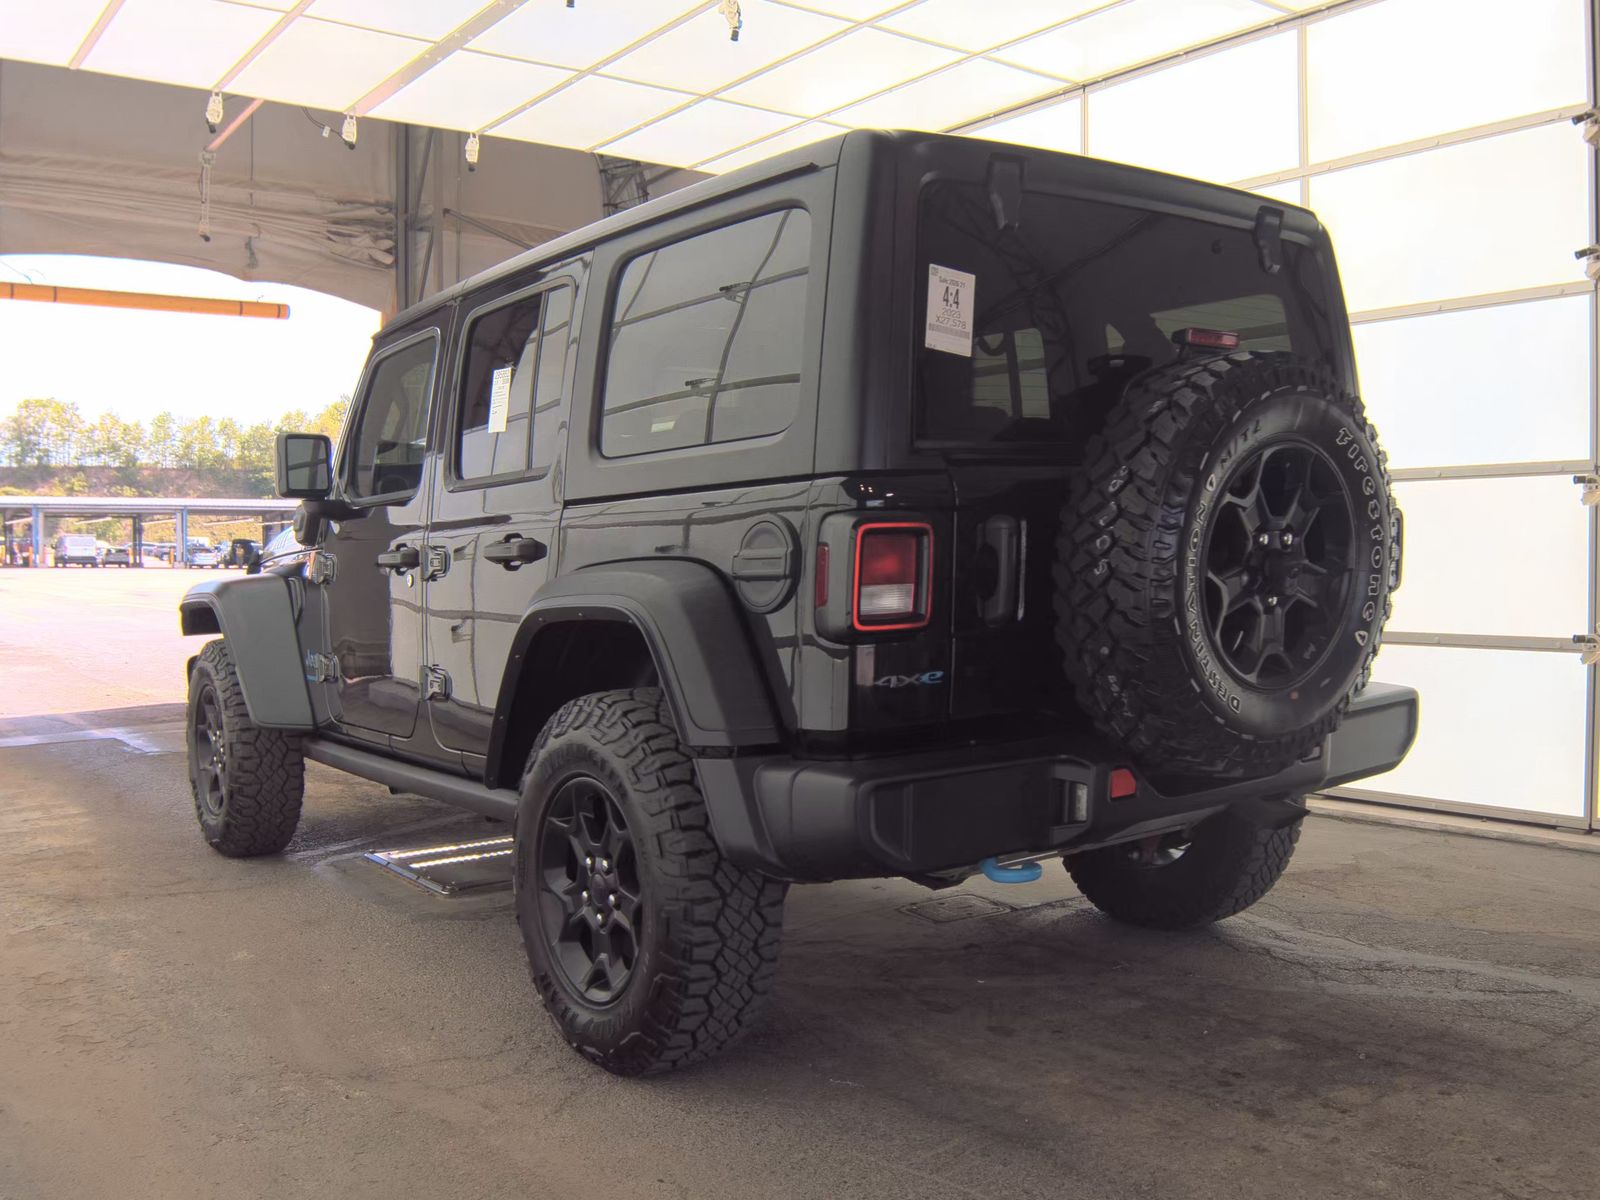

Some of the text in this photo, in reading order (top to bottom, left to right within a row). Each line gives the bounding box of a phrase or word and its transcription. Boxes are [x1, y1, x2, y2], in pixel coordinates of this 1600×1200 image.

[941, 307, 961, 319] 2023
[942, 286, 960, 309] 4:4
[1336, 427, 1384, 621] Firestone
[1186, 502, 1241, 714] DESTINATION
